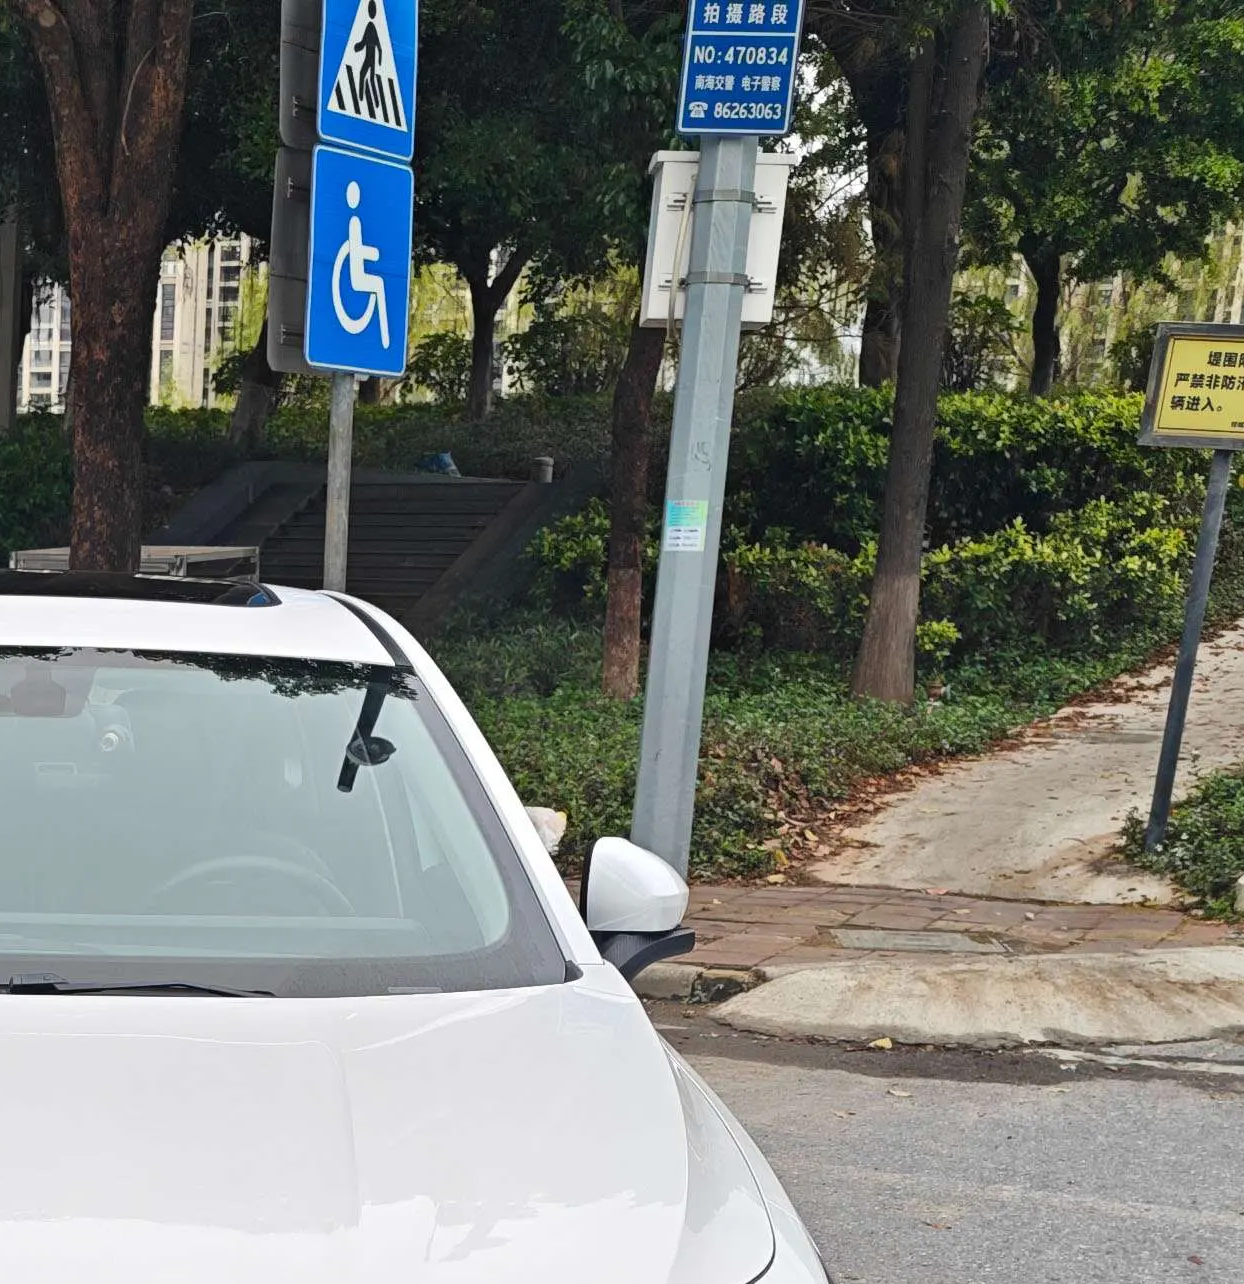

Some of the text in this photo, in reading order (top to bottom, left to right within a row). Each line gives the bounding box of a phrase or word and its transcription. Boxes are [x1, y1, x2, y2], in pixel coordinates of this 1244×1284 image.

[703, 3, 788, 25] 拍摄路段
[693, 45, 788, 65] NO:470834
[694, 74, 782, 92] 南海交警 电子警察
[713, 103, 782, 119] 86263063
